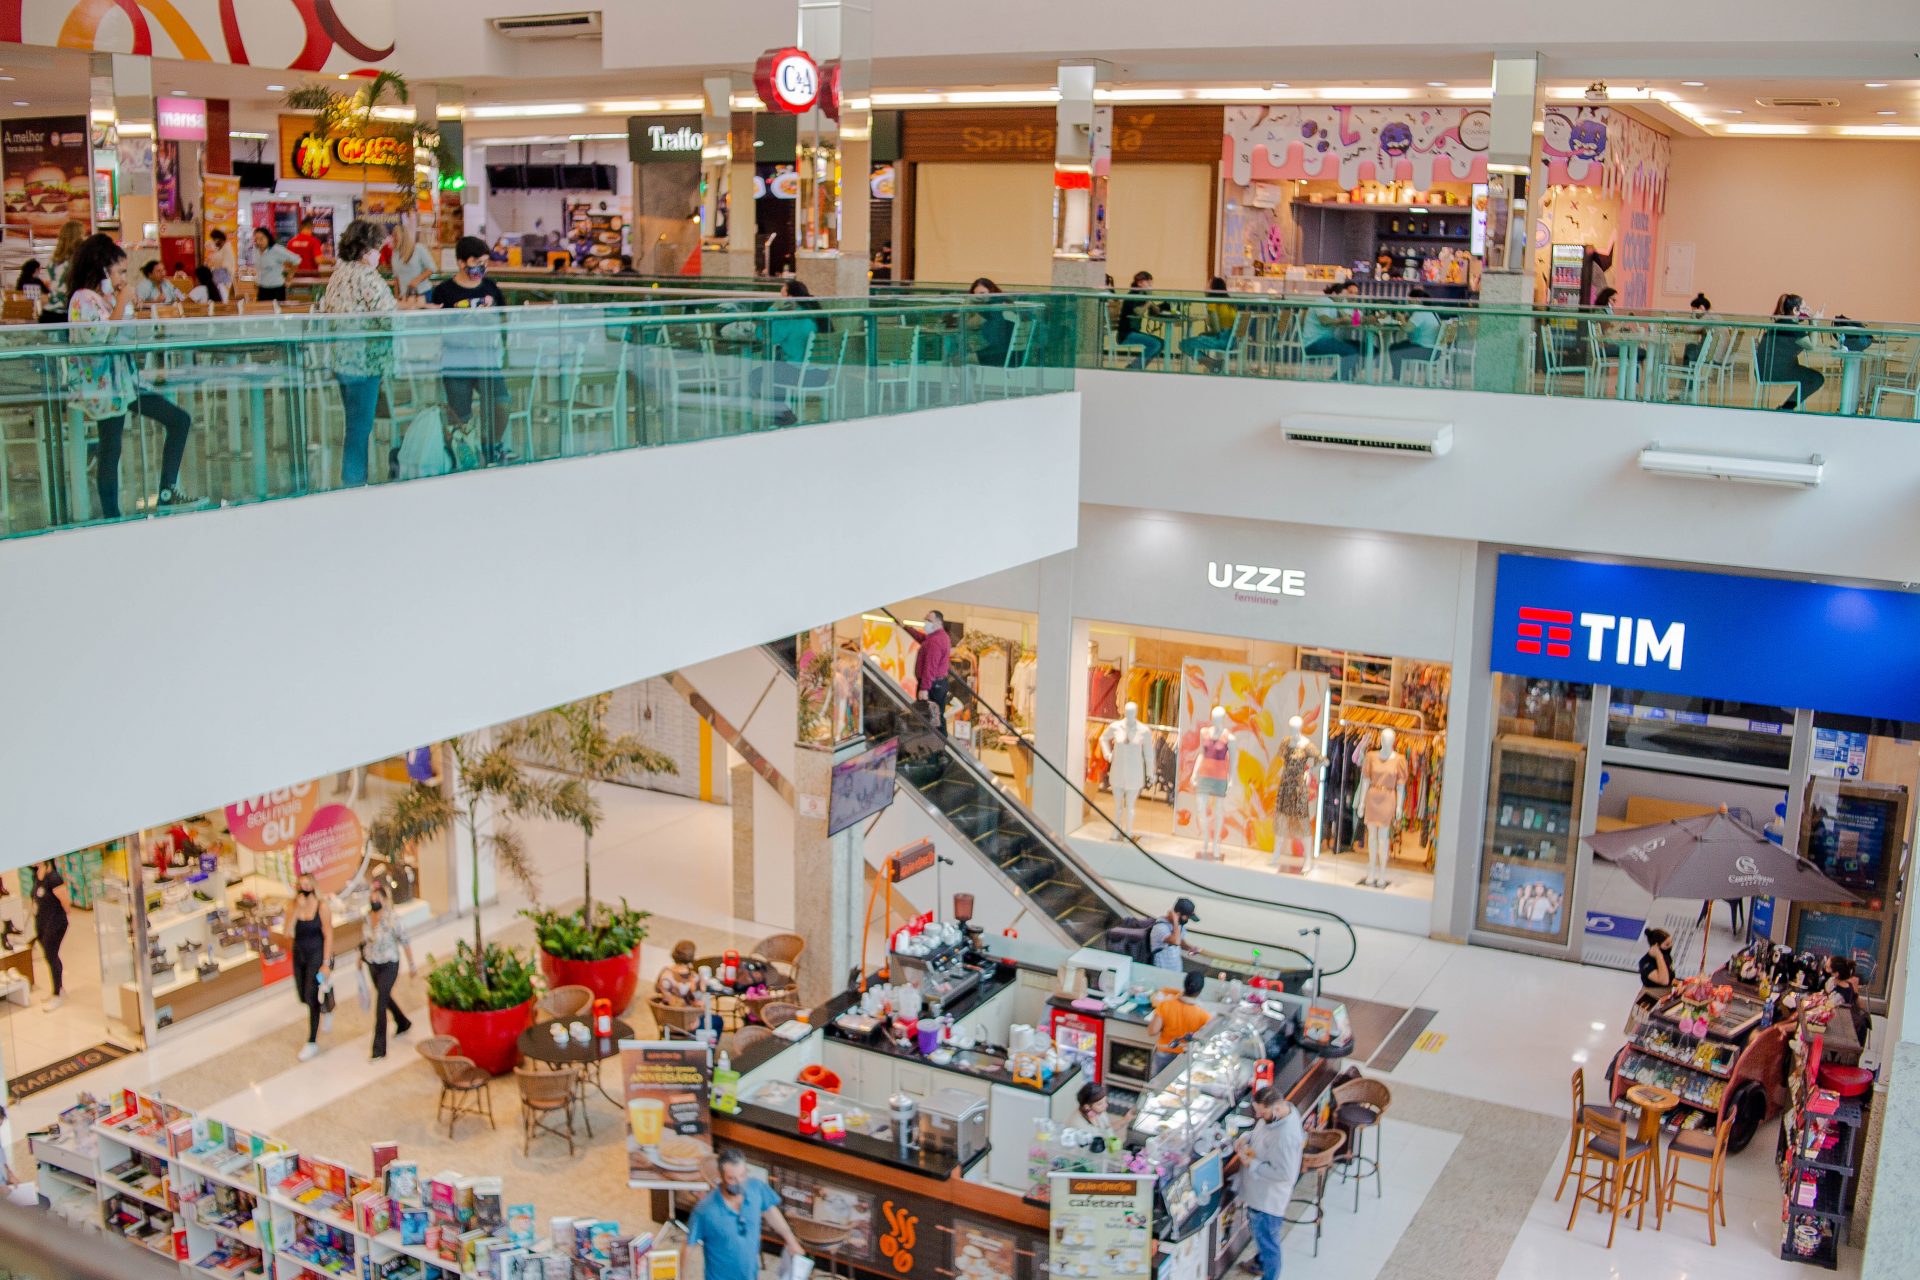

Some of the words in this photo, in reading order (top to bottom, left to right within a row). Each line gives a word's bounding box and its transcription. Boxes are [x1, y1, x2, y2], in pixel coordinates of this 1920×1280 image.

[783, 64, 814, 95] C&A
[159, 111, 205, 129] marisa
[4, 131, 12, 144] A
[13, 129, 45, 144] melhor
[1208, 561, 1306, 597] UZZE
[1234, 592, 1279, 606] feminine
[1580, 612, 1686, 671] TIM
[246, 809, 271, 829] sou
[271, 799, 302, 820] mais
[261, 815, 296, 846] eu
